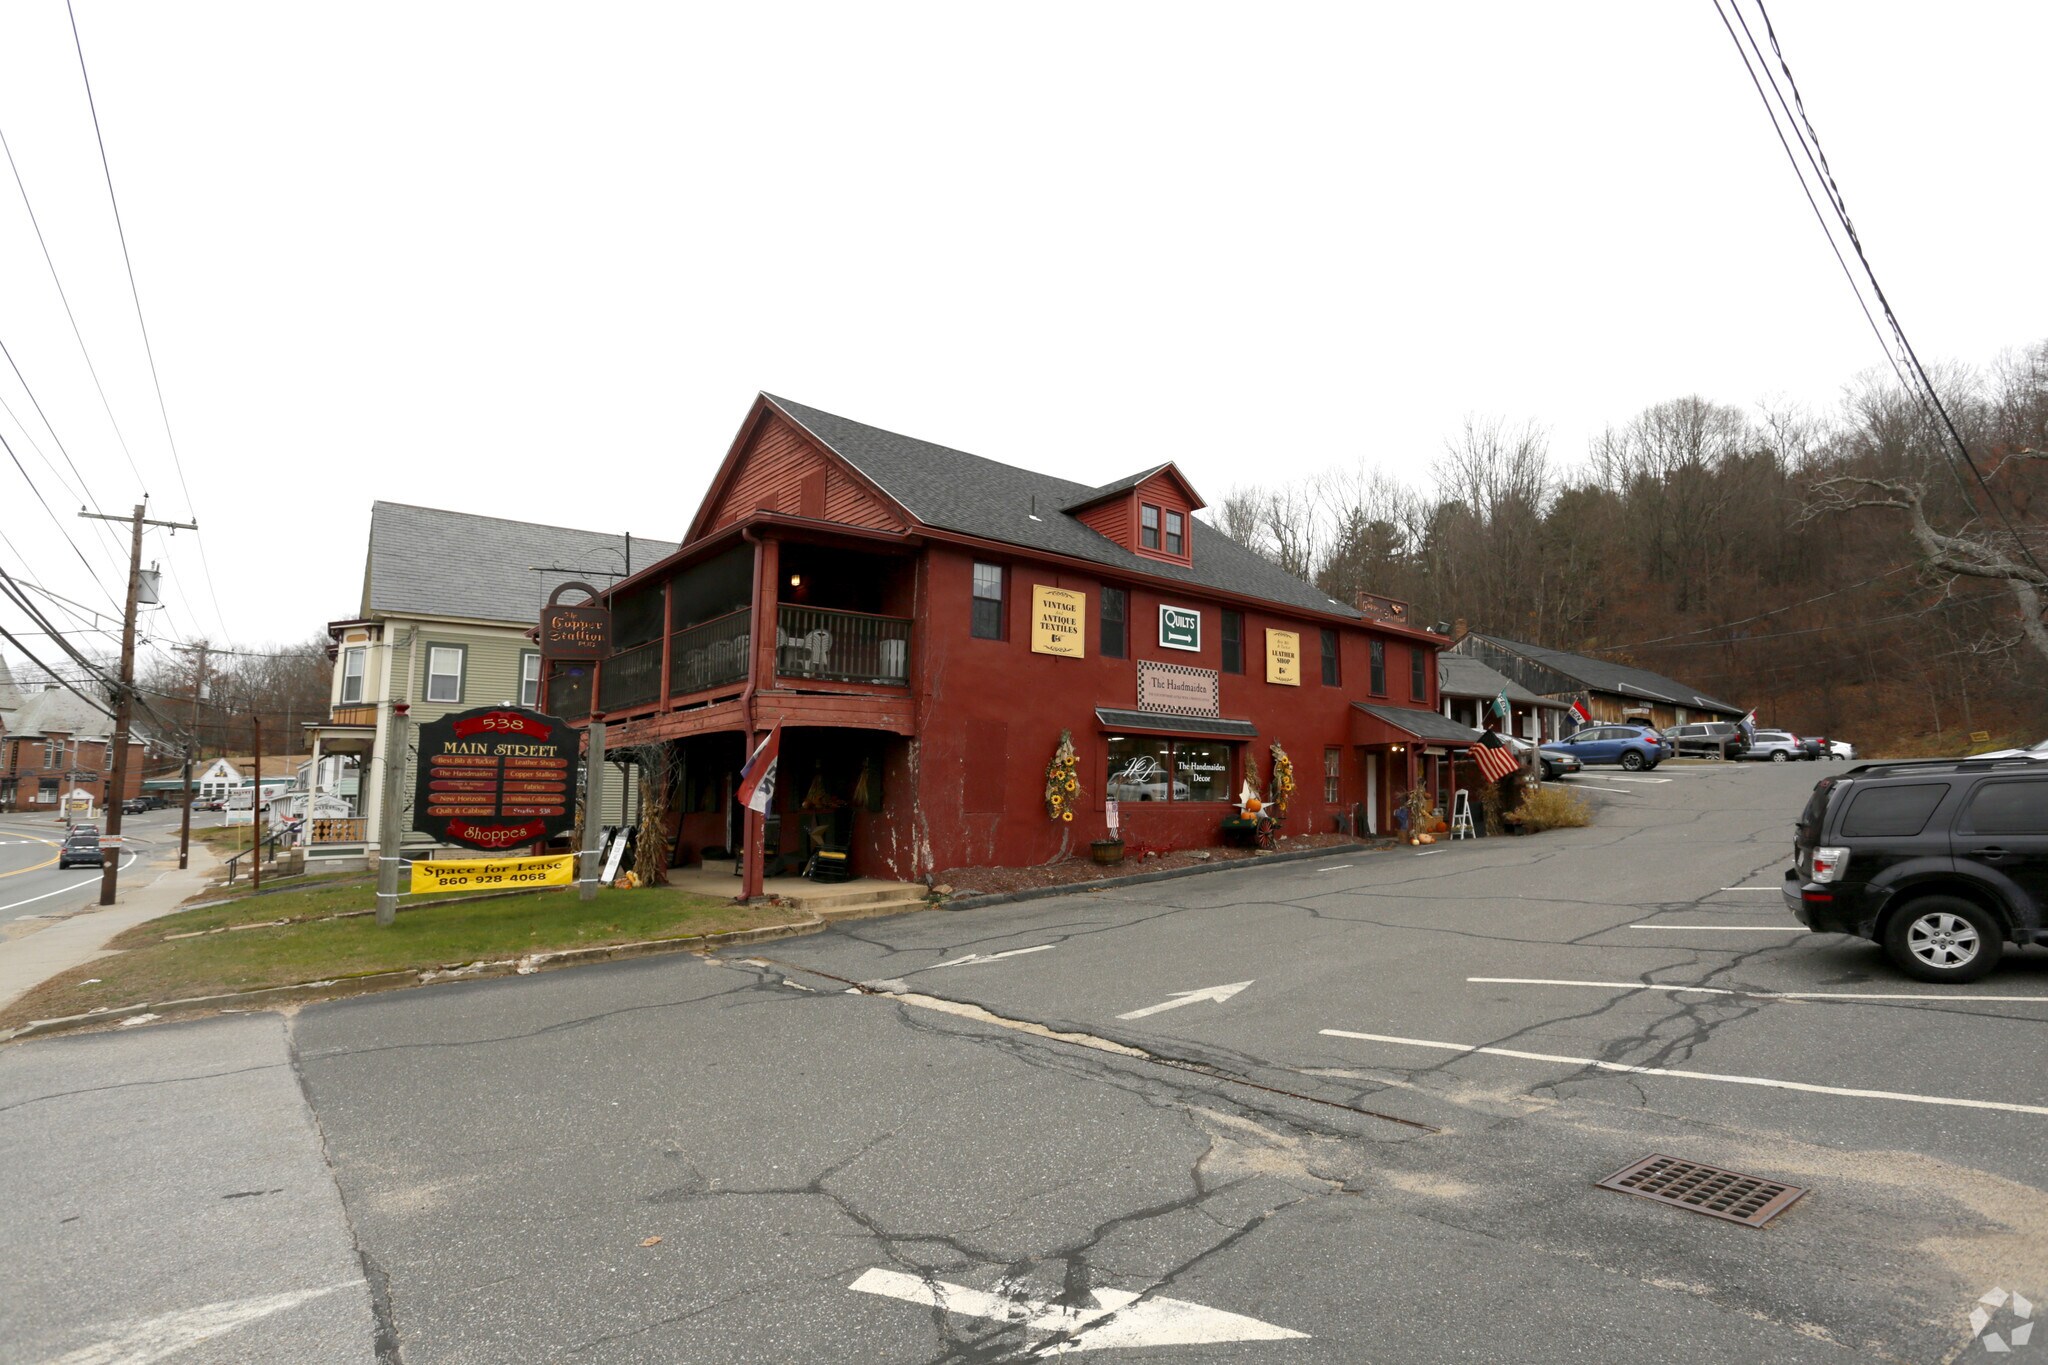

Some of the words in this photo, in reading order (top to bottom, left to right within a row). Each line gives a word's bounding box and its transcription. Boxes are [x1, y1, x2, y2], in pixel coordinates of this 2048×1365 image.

[1043, 600, 1077, 612] VINTAGE
[552, 616, 603, 630] Copper
[1042, 614, 1077, 625] ANTIQUE
[1165, 610, 1195, 629] QUILTS
[1040, 622, 1078, 634] TEXTILES
[549, 630, 605, 642] Stallion
[1272, 650, 1295, 658] LEATHER
[1151, 677, 1165, 688] The
[1167, 679, 1207, 693] Handmaiden
[1570, 708, 1582, 721] PEN
[483, 719, 524, 730] 538
[444, 742, 487, 754] MAIN
[494, 743, 557, 757] STREET
[1178, 762, 1190, 770] The
[1191, 762, 1225, 771] Handmaiden
[1193, 773, 1211, 782] Décor
[464, 826, 527, 842] Shoppes
[423, 866, 475, 878] Space
[484, 864, 510, 874] for
[517, 862, 562, 872] Lease
